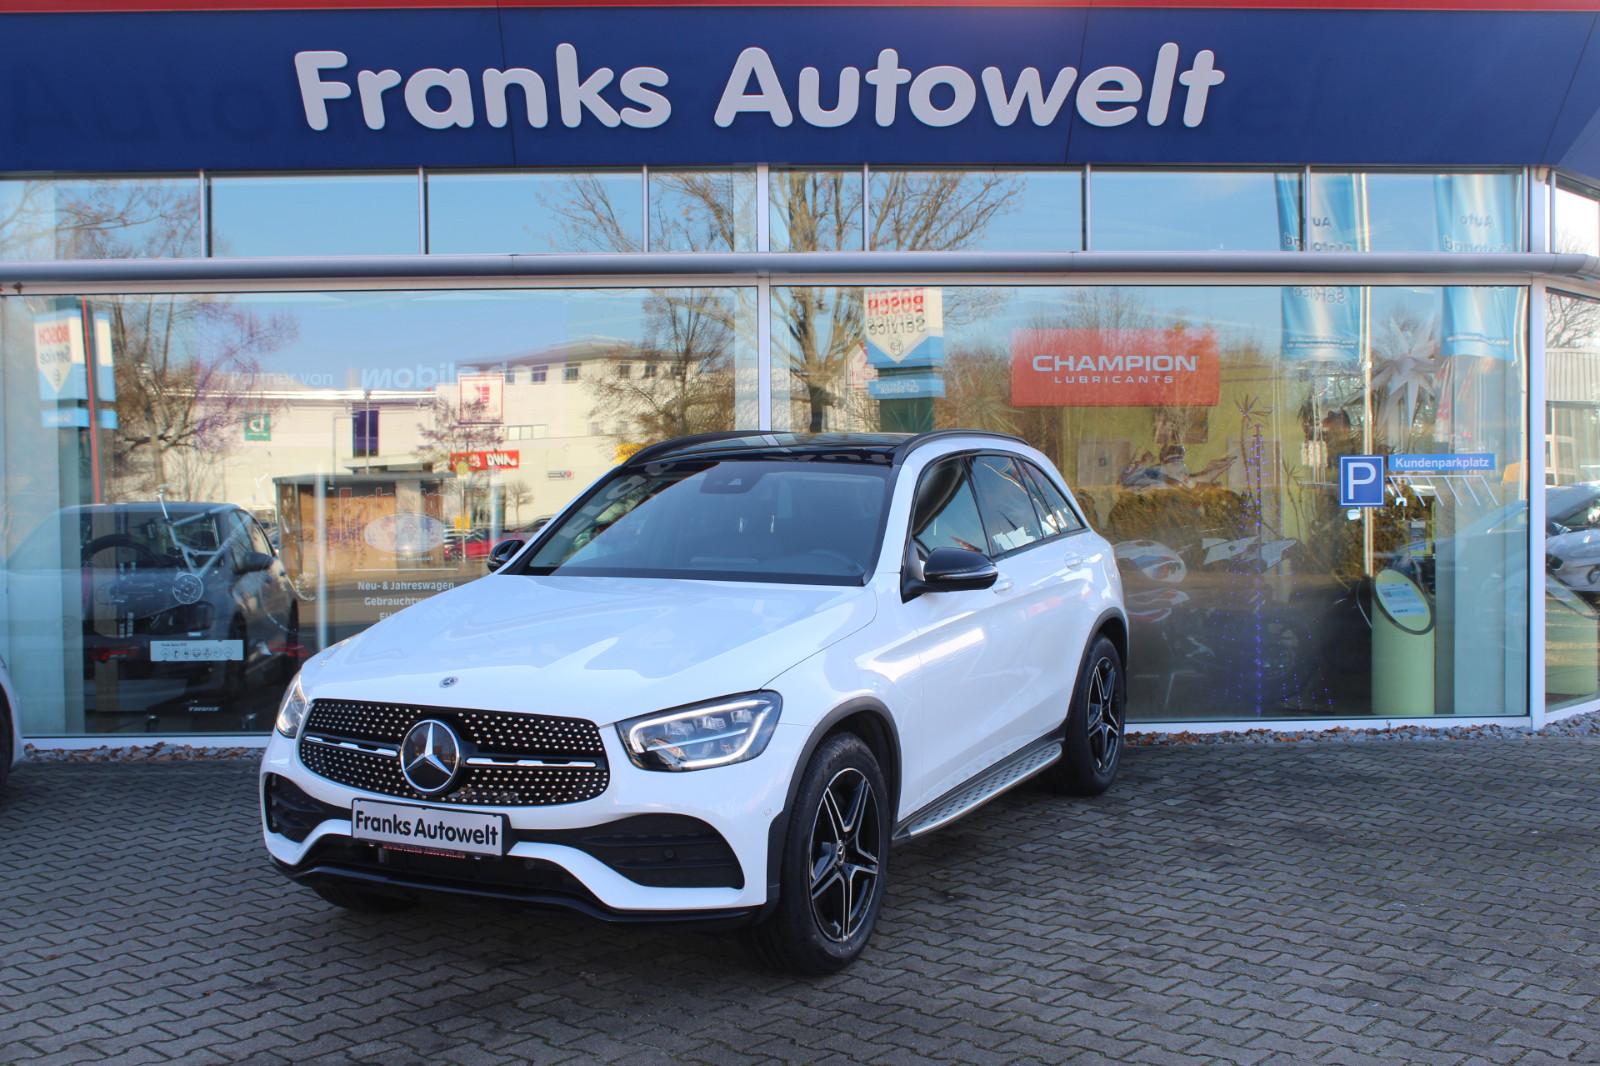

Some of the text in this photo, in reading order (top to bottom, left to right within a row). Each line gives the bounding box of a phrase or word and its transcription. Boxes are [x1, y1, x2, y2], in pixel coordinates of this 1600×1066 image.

[293, 41, 1226, 132] Franks Autowelt
[1032, 355, 1198, 372] CHAMPION
[300, 373, 334, 386] von
[1054, 375, 1175, 384] LUBRICANTS
[1395, 457, 1489, 469] Kundenparkplatz
[1347, 462, 1376, 500] P
[357, 581, 381, 590] Neu-
[390, 580, 455, 592] Jahreswagen
[355, 810, 498, 846] Franks Autowelt
